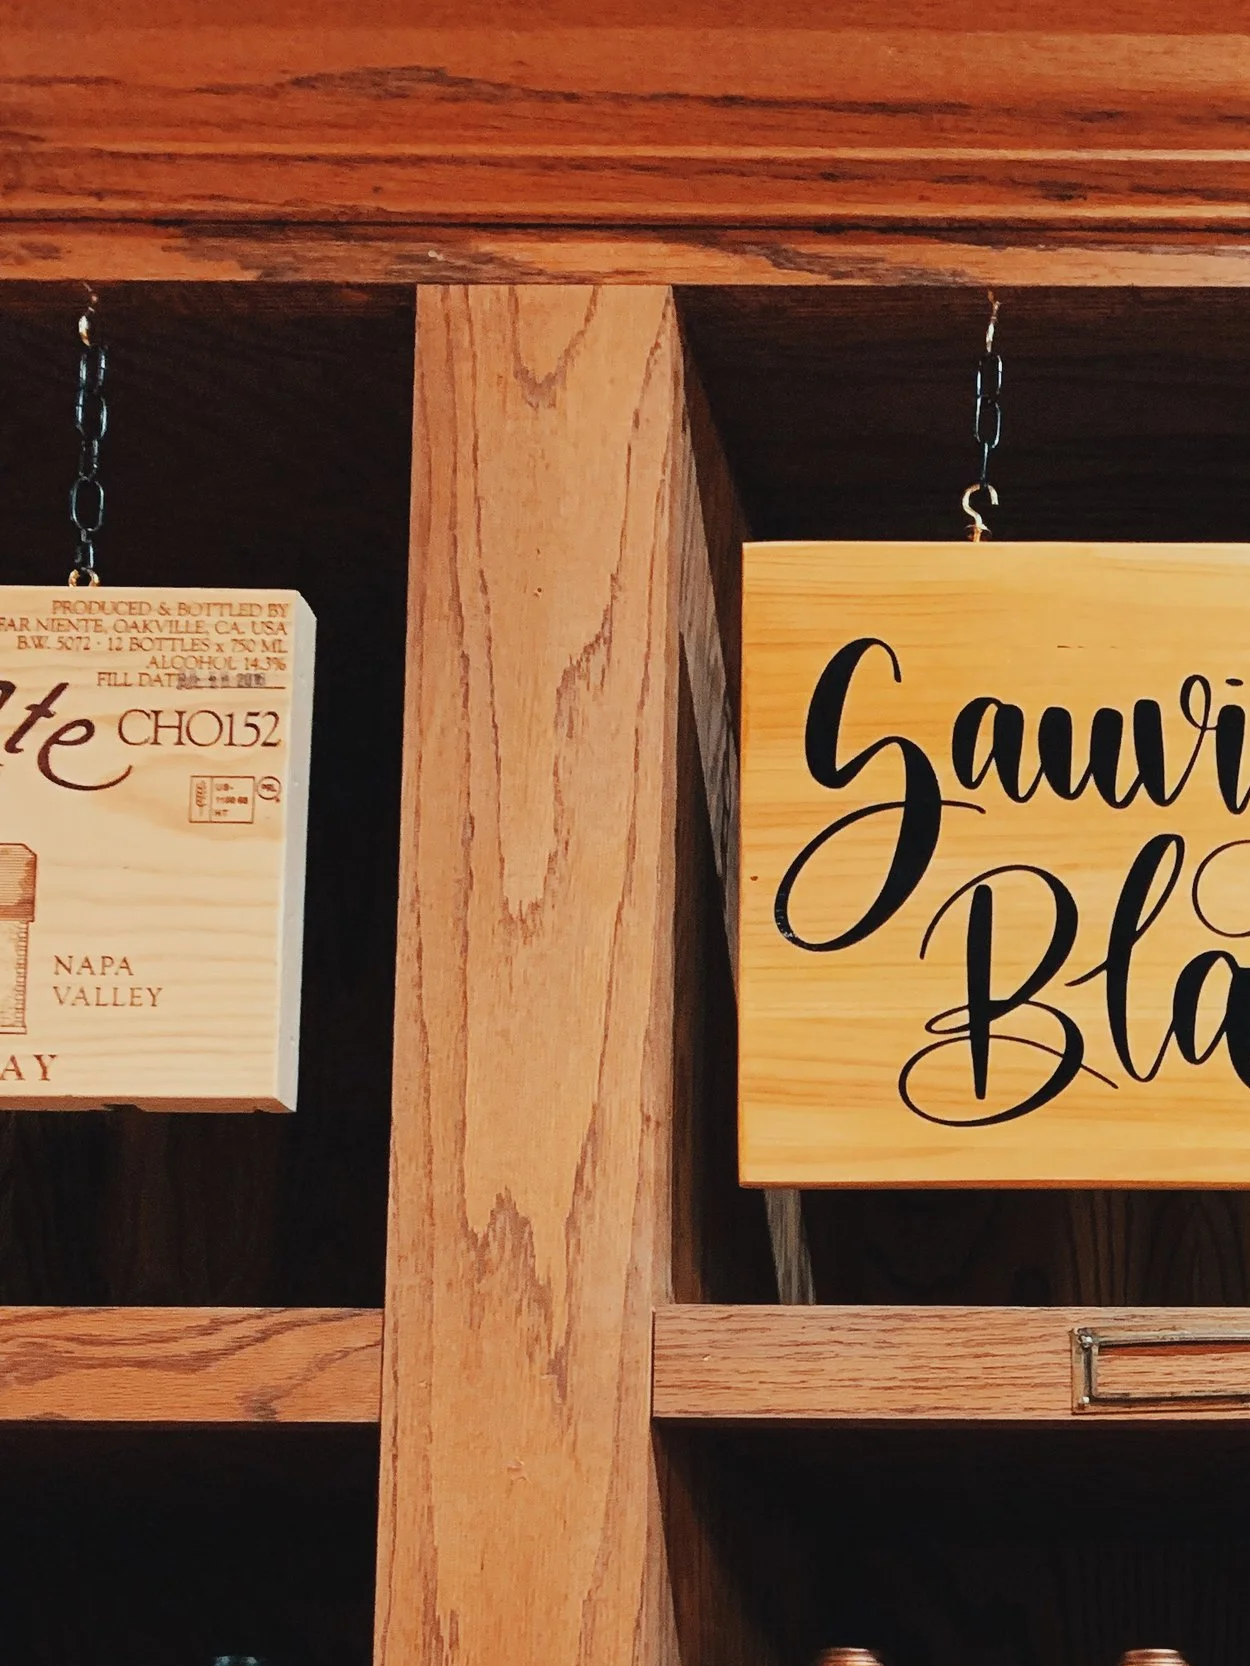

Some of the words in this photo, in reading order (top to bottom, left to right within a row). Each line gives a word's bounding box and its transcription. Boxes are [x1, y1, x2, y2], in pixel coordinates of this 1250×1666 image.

[52, 600, 152, 617] PRODUCED
[158, 602, 172, 616] &
[178, 602, 262, 617] BOTTLED
[268, 603, 289, 618] BY
[251, 621, 288, 636] USA
[108, 637, 124, 652] 12
[129, 637, 210, 652] BOTTLES
[261, 639, 289, 654] ML
[146, 655, 237, 671] ALCOHOL
[97, 672, 132, 687] FILL
[54, 954, 134, 976] NAPA
[53, 985, 163, 1007] VALLEY
